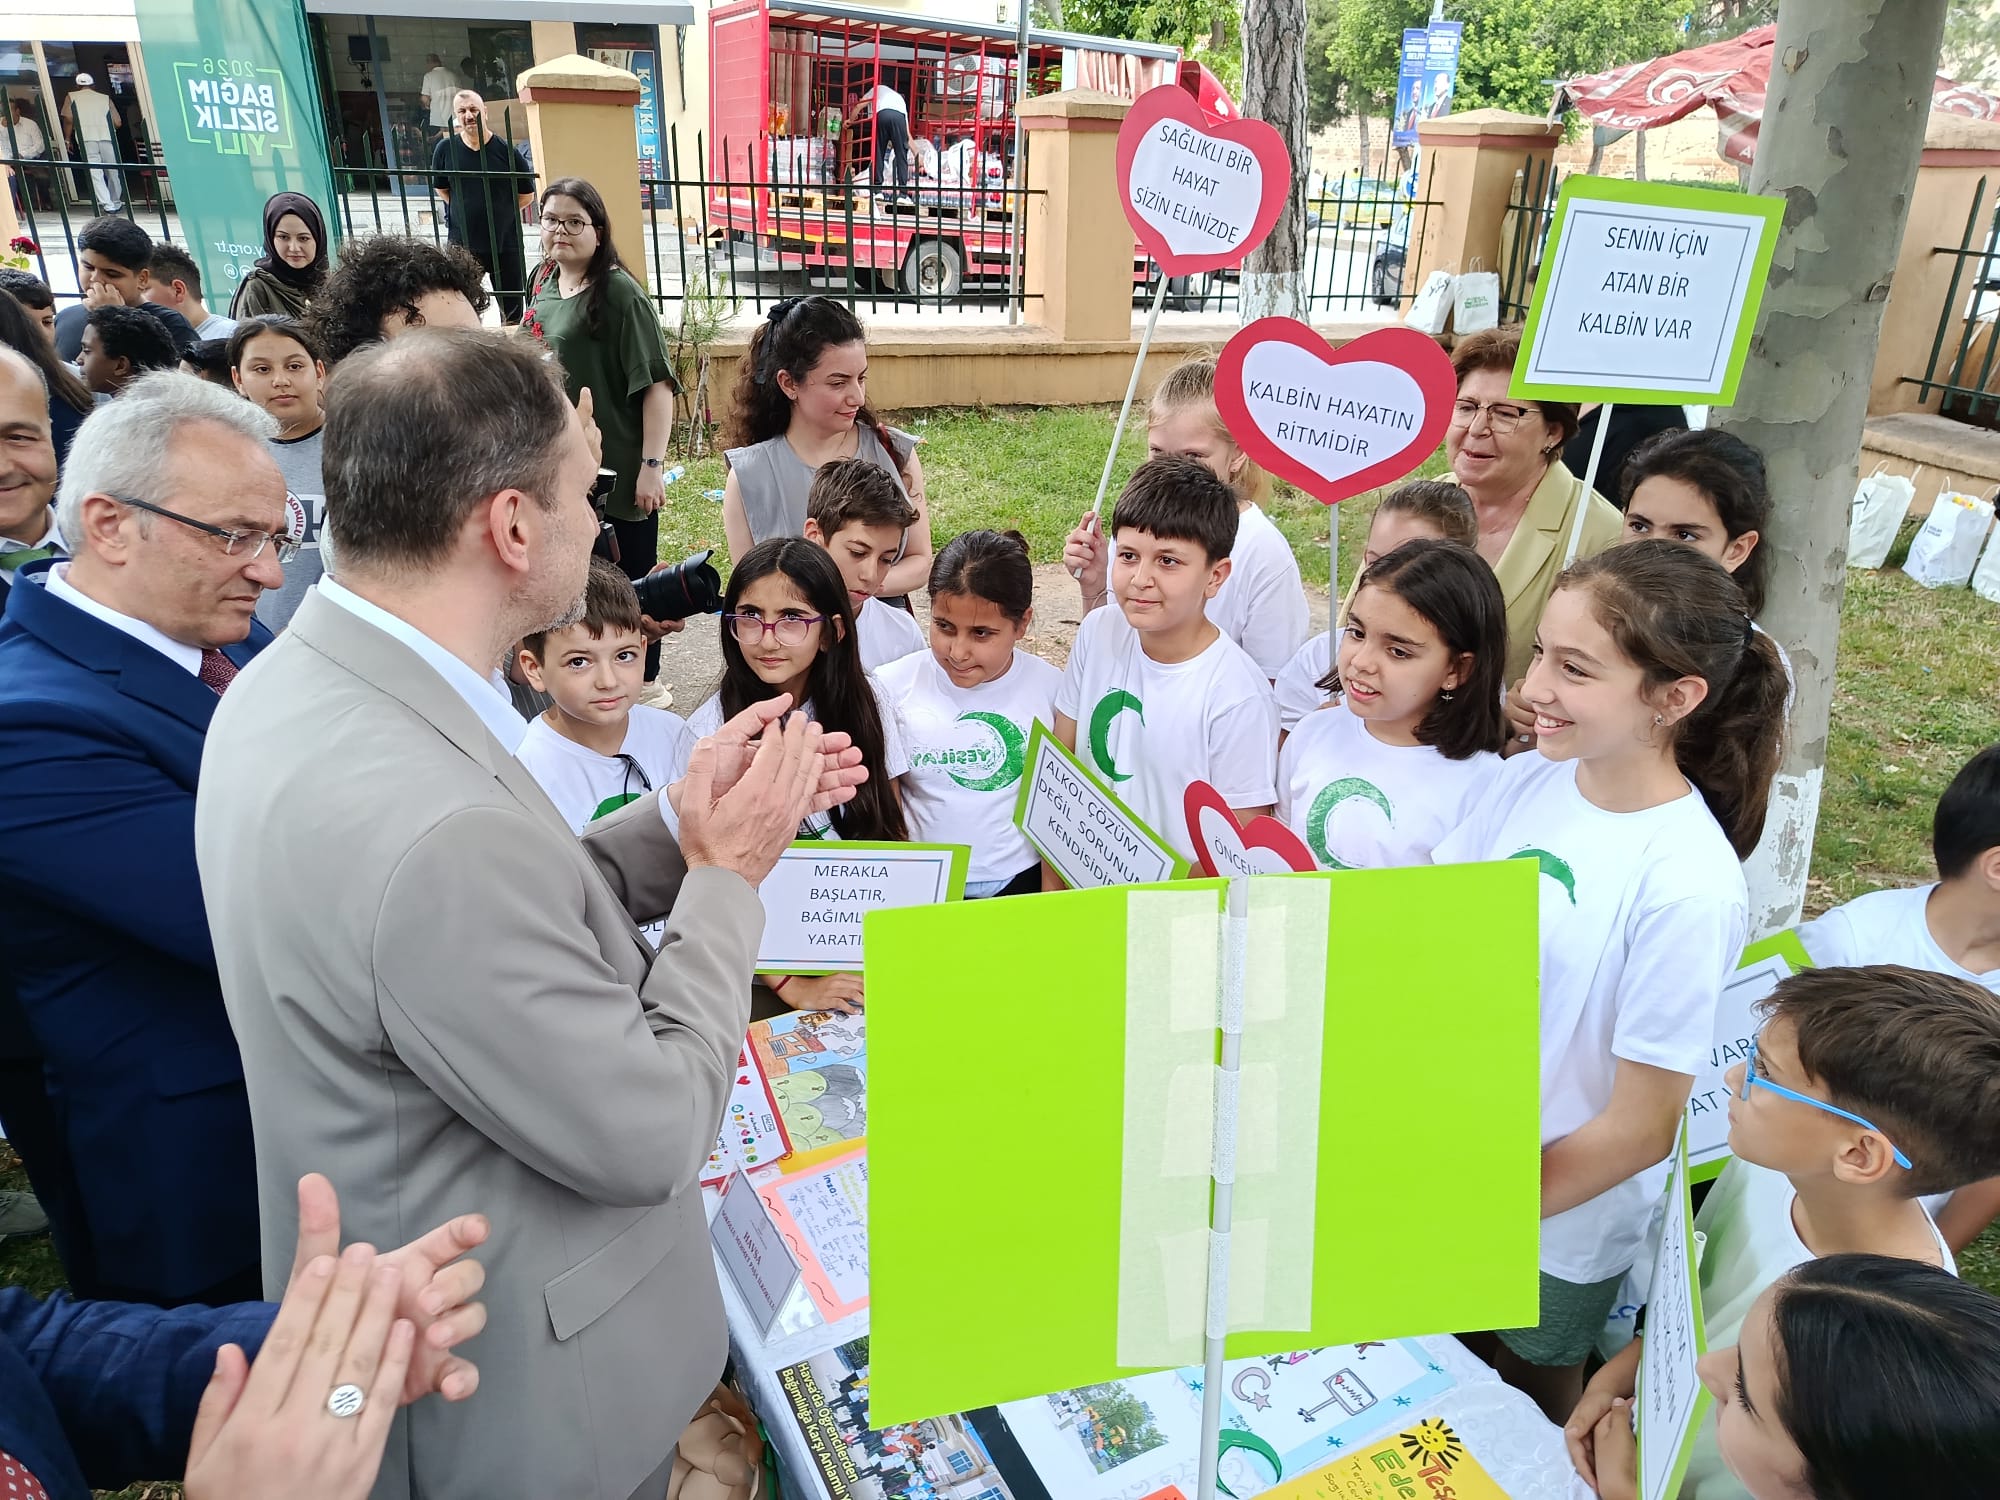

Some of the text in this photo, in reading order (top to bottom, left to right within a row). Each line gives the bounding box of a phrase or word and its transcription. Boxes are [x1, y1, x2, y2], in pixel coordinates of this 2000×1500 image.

[636, 67, 658, 134] KANKİ
[1159, 125, 1253, 175] SAĞLIKLI BİR
[1172, 165, 1220, 197] HAYAT
[1134, 186, 1239, 244] SİZİN ELİNİZDE
[1604, 225, 1709, 260] SENİN İÇİN
[1601, 271, 1689, 298] ATAN BİR
[1578, 311, 1692, 339] KALBİN VAR
[1249, 380, 1414, 431] KALBİN HAYATIN
[1277, 421, 1369, 457] RİTMİDİR
[286, 495, 304, 537] KOKULU
[1038, 778, 1072, 822] DEĞİL
[1046, 760, 1139, 857] ALKOL ÇÖZÜM
[814, 864, 889, 878] MERAKLA
[810, 888, 887, 903] BAŞLATIR,
[801, 909, 864, 924] BAĞIML
[808, 934, 865, 946] YARATI
[743, 1231, 762, 1266] HAVSA
[806, 1422, 826, 1453] Karşı
[818, 1450, 847, 1496] Anlamlı
[818, 1406, 860, 1483] Öğrencilerden
